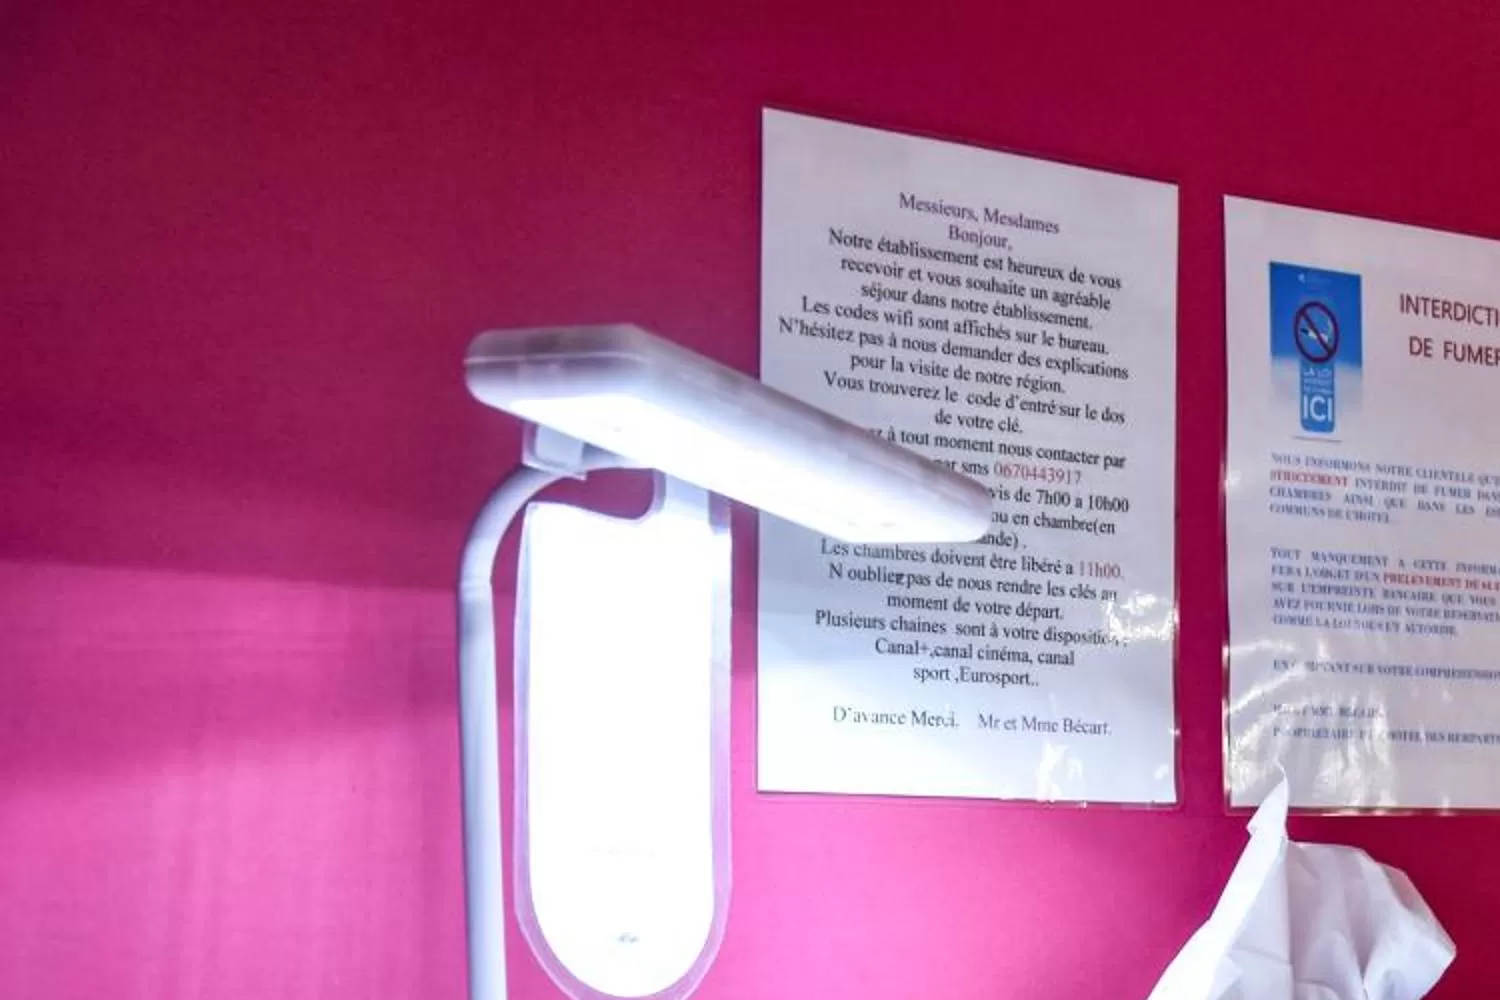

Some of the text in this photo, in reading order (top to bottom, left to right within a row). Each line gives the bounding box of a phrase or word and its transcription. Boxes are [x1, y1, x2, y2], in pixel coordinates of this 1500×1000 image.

[983, 207, 1060, 234] Mesdames
[948, 224, 1013, 252] Bonjour,
[828, 227, 1122, 291] Notre établissement est heureux de vous
[840, 255, 1112, 312] recevoir et vous souhaite un agréable
[860, 281, 1093, 331] séjour dans notre établissement.
[802, 295, 832, 316] Les
[834, 303, 879, 323] codes
[883, 308, 914, 328] wifi
[917, 316, 950, 333] sont
[953, 318, 1012, 342] affichés
[1014, 329, 1039, 345] sur
[1041, 330, 1056, 348] le
[858, 330, 885, 348] pas
[887, 331, 898, 349] à
[901, 336, 940, 354] nous
[941, 338, 1016, 365] demander
[1016, 347, 1044, 368] des
[1045, 355, 1129, 381] explications
[1408, 335, 1434, 359] DE
[850, 354, 1066, 394] pour la visite de notre région.
[823, 370, 864, 392] Vous
[868, 378, 941, 401] trouverez
[944, 384, 962, 404] le
[965, 390, 1002, 409] code
[1058, 402, 1082, 420] sur
[1084, 403, 1098, 421] le
[1101, 406, 1126, 425] dos
[1303, 395, 1333, 423] ICI
[933, 408, 1024, 435] de votre clé.
[898, 430, 930, 448] tout
[933, 435, 995, 454] moment
[997, 442, 1033, 460] nous
[1035, 447, 1101, 465] contacter
[1103, 451, 1127, 470] par
[960, 460, 990, 478] sms
[993, 461, 1082, 485] 0670443917
[1013, 485, 1032, 504] de
[1035, 488, 1071, 508] 7h00
[1074, 496, 1083, 509] a
[1087, 494, 1130, 513] 10h00
[1011, 511, 1030, 528] en
[819, 539, 850, 557] Les
[851, 543, 928, 564] chambres
[928, 548, 986, 569] doivent
[989, 554, 1018, 571] être
[1021, 556, 1064, 576] libéré
[1064, 563, 1075, 576] a
[828, 562, 843, 580] N
[905, 573, 932, 589] pas
[934, 571, 954, 589] de
[957, 577, 993, 592] nous
[996, 578, 1043, 596] rendre
[1046, 580, 1067, 598] les
[1069, 583, 1097, 602] clés
[886, 593, 1064, 622] moment de votre départ.
[815, 609, 888, 632] Plusieurs
[889, 615, 947, 635] chaines
[955, 622, 986, 641] sont
[988, 622, 999, 639] à
[1001, 623, 1040, 641] votre
[976, 645, 1033, 665] cinéma,
[1037, 651, 1075, 666] canal
[913, 665, 951, 684] sport
[978, 712, 1001, 730] Mr
[1003, 718, 1018, 732] et
[1021, 715, 1059, 733] Mme
